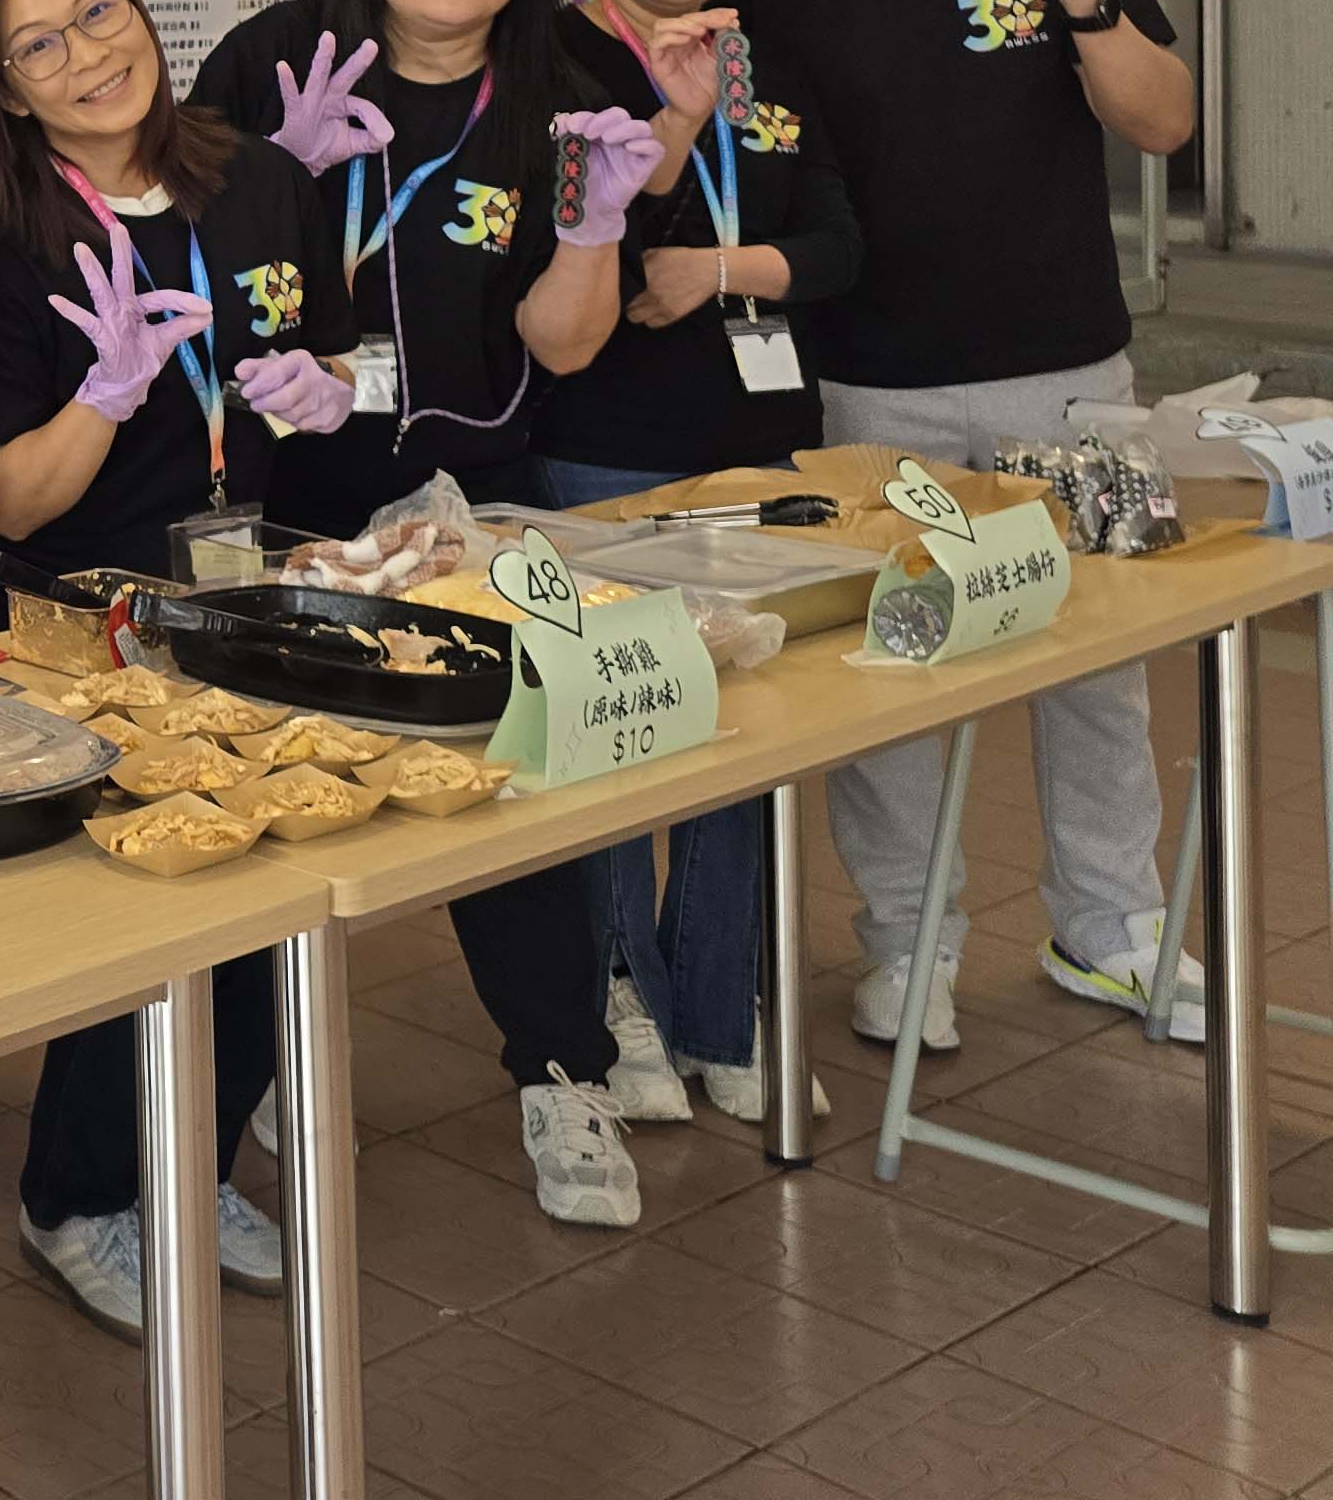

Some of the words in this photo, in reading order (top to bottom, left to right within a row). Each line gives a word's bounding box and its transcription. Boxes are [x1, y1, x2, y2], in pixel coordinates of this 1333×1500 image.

[903, 483, 956, 519] 50
[526, 560, 570, 604] 48
[612, 725, 655, 765] $10
